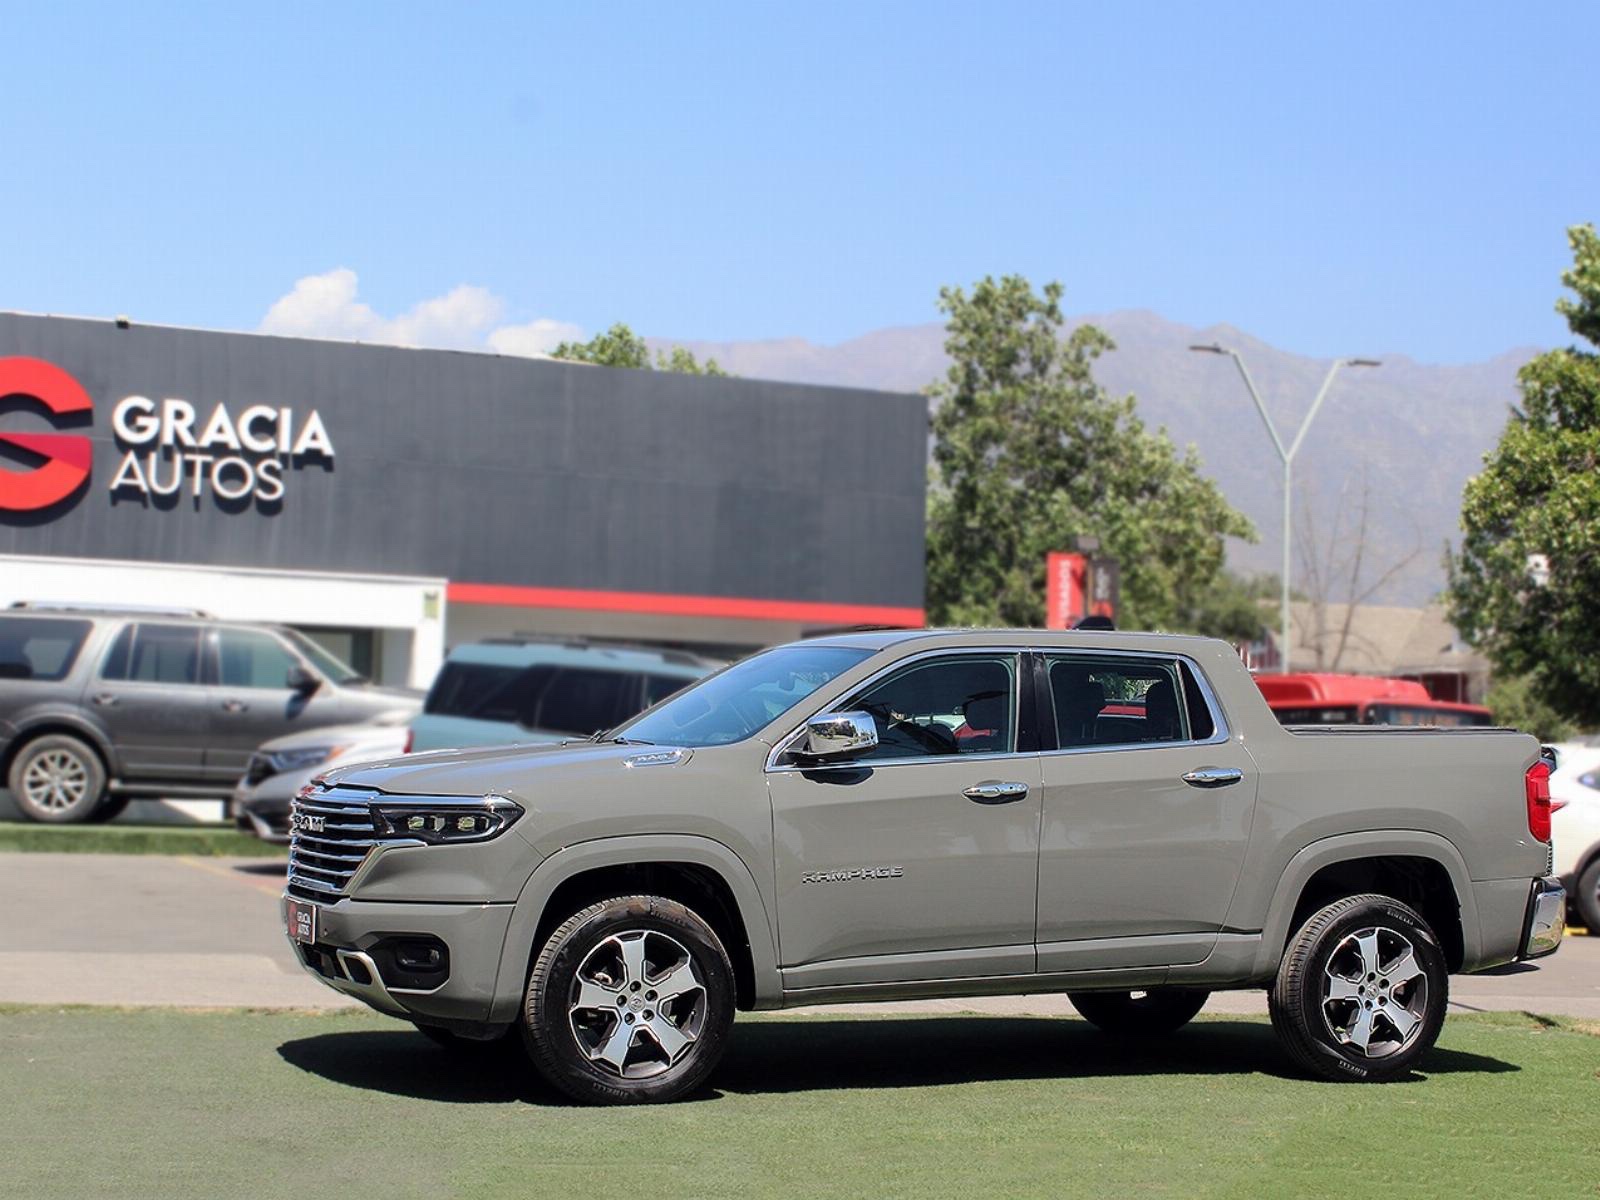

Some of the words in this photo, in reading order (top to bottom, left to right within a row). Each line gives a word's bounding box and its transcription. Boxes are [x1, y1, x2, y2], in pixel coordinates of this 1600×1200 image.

[112, 396, 335, 456] GRACIA
[110, 450, 285, 501] AUTOS
[801, 865, 904, 884] RAMPAGE
